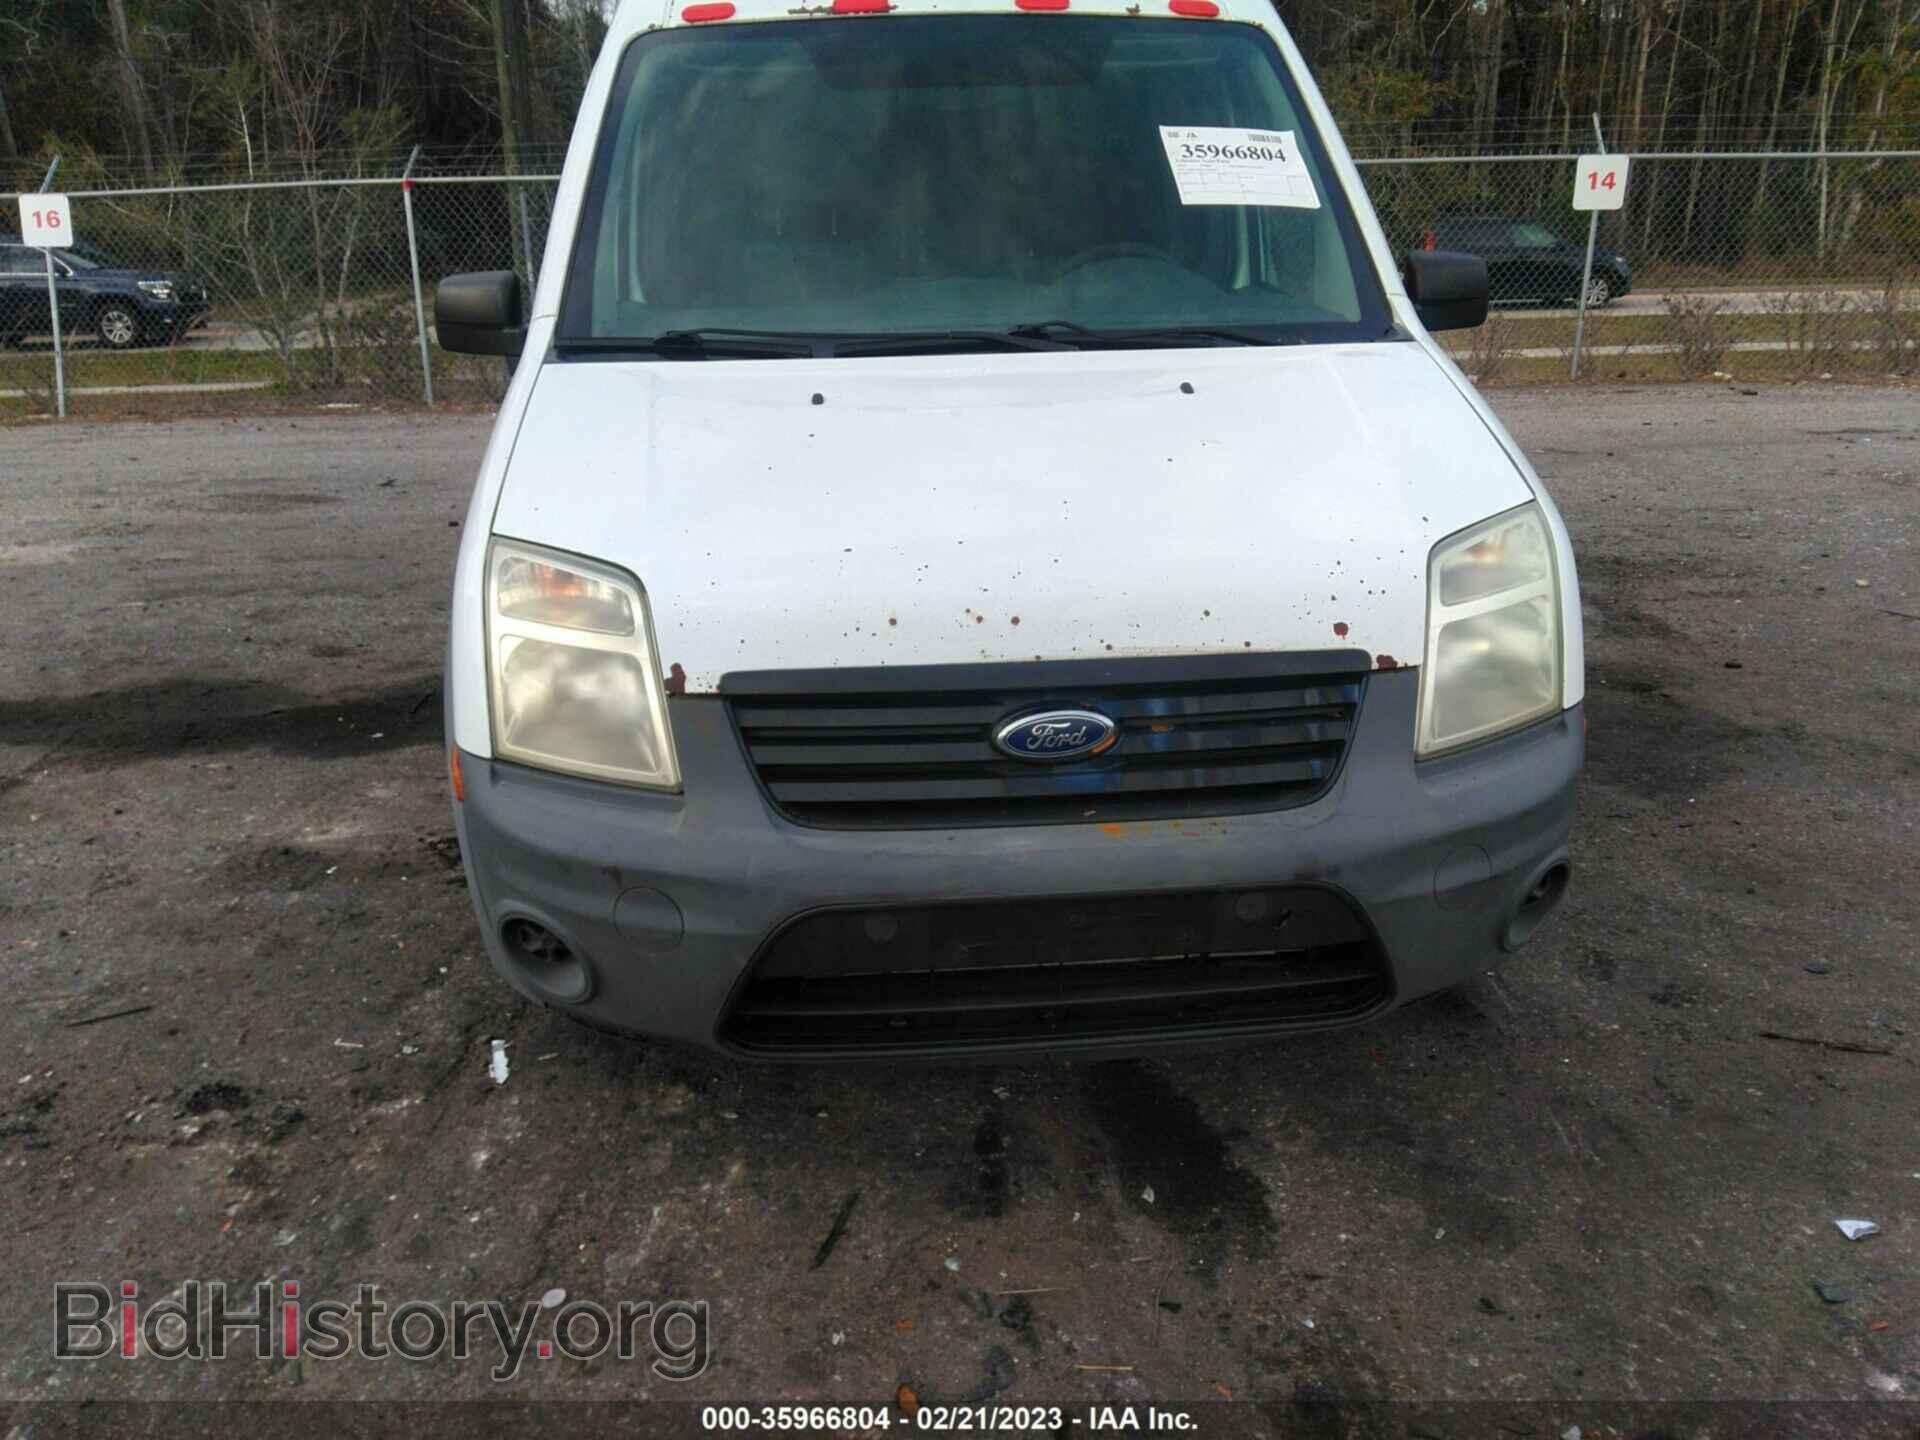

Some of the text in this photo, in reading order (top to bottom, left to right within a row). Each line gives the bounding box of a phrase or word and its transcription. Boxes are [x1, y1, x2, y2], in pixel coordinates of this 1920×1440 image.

[1179, 143, 1287, 163] 35966804
[1588, 171, 1617, 190] 14
[32, 210, 61, 228] 16
[1026, 722, 1088, 750] Ford
